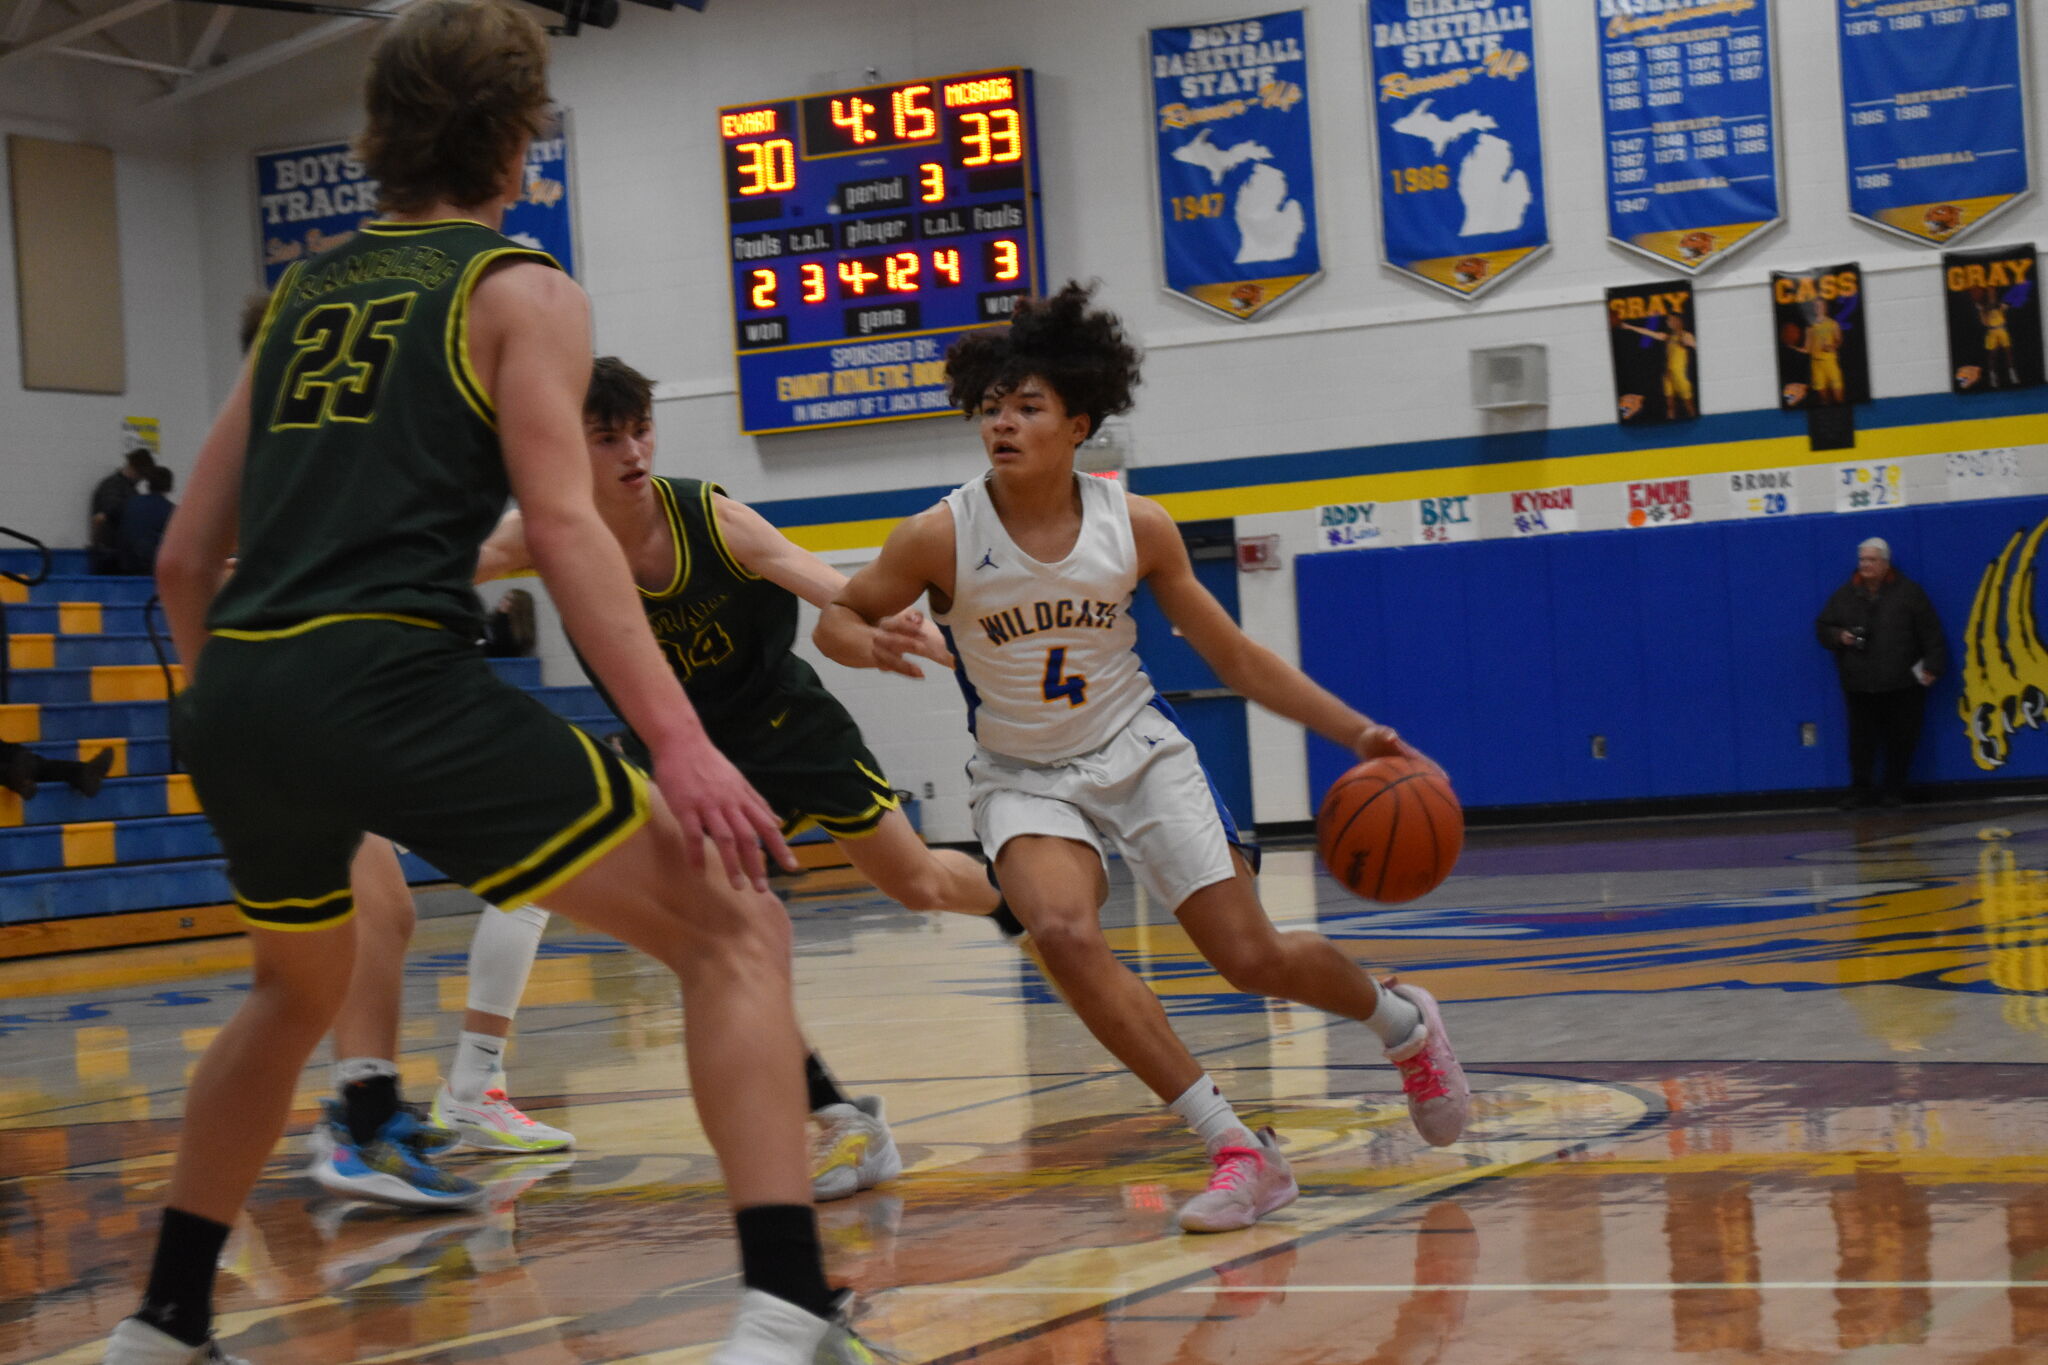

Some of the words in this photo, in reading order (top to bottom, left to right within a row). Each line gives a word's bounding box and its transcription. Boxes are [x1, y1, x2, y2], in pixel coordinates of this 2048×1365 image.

[1189, 21, 1263, 49] BOYS
[1374, 5, 1530, 47] BASKETBALL
[1154, 38, 1302, 78] BASKETBALL
[1403, 34, 1503, 68] STATE
[1181, 65, 1277, 98] STATE
[830, 86, 936, 143] 4:15
[959, 109, 1021, 166] 33
[275, 154, 366, 189] BOYS
[736, 139, 796, 195] 30
[919, 163, 945, 202] 3
[263, 181, 381, 223] TRACK
[845, 177, 904, 210] period
[734, 233, 781, 260] fouls
[846, 219, 907, 247] player
[973, 205, 1022, 230] fouls
[752, 269, 776, 309] 2
[801, 264, 826, 302] 3
[933, 250, 960, 283] 4
[993, 240, 1019, 281] 3
[1774, 270, 1857, 304] CASS
[1947, 258, 2033, 291] GRAY
[859, 308, 906, 334] game
[1610, 291, 1689, 320] GRAY
[270, 291, 419, 432] 25
[1321, 503, 1375, 526] ADDY
[1420, 496, 1470, 525] BRI
[978, 599, 1117, 646] WILDCATS
[1040, 646, 1087, 709] 4
